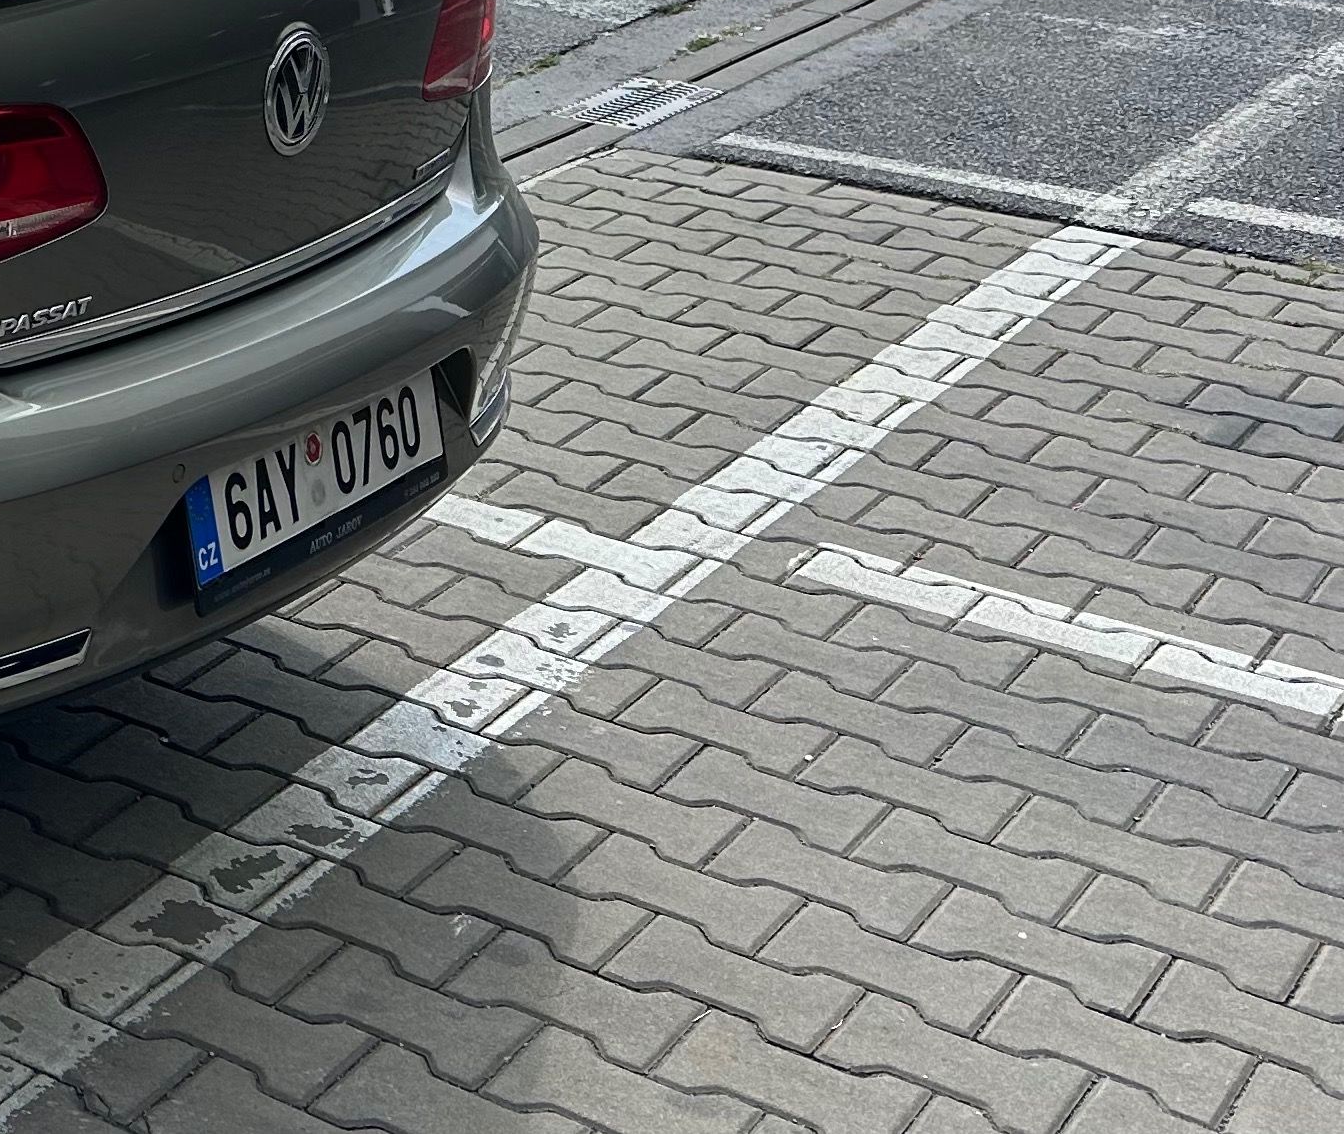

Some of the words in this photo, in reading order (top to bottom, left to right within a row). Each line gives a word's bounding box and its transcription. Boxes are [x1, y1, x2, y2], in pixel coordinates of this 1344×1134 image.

[224, 443, 299, 550] 6AY
[331, 385, 421, 495] 0760
[198, 541, 219, 571] CZ
[309, 531, 333, 555] AUTO
